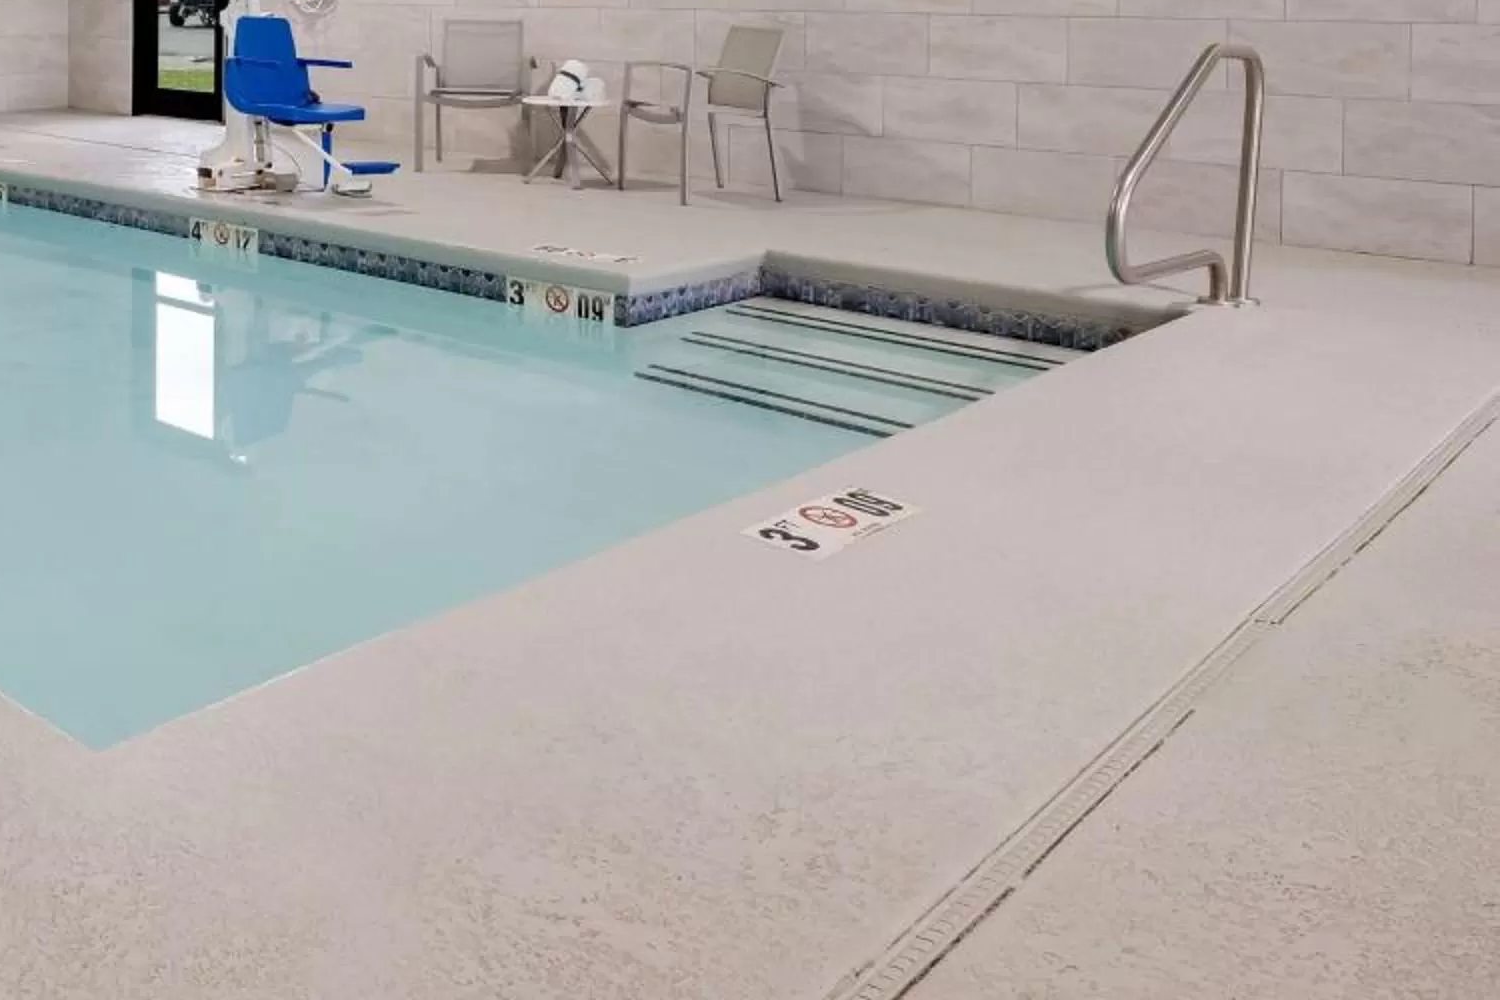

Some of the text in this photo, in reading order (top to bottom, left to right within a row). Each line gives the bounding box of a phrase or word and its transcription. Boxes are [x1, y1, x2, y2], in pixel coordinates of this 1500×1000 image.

[191, 220, 202, 242] 4
[508, 279, 604, 322] 3 09
[759, 527, 820, 551] 3
[832, 491, 904, 517] 09
